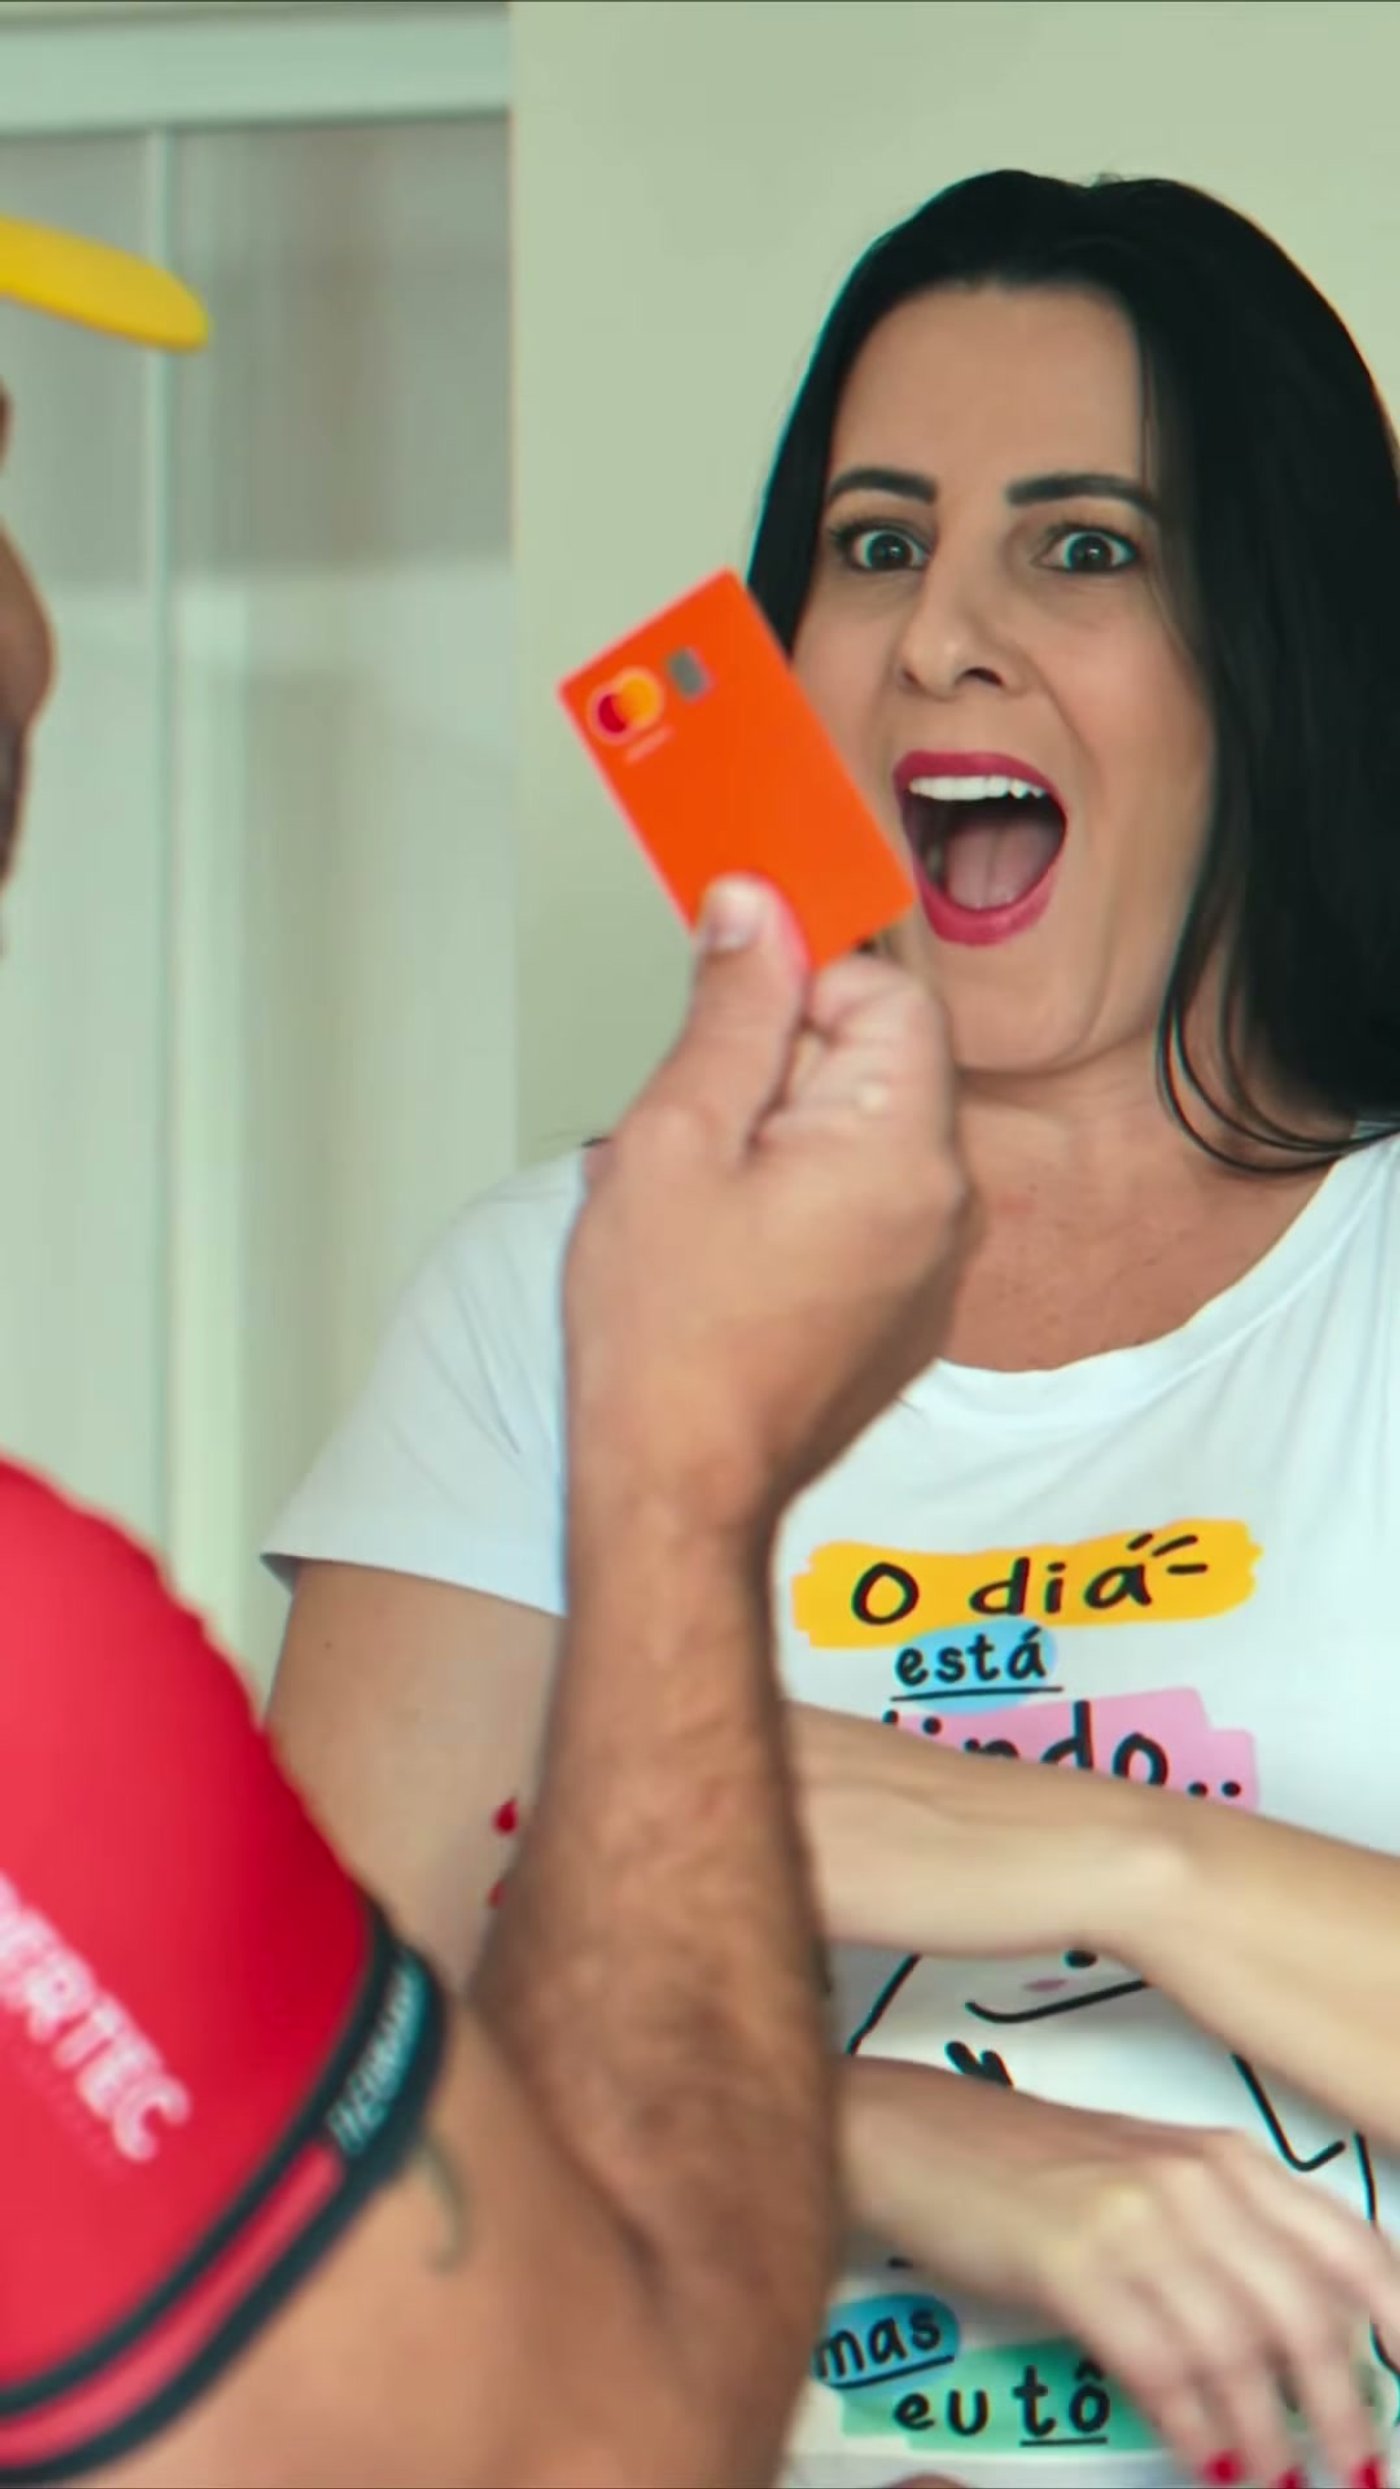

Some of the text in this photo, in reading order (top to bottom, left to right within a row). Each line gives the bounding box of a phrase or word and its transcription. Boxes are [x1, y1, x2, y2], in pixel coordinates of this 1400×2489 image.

[850, 1562, 919, 1626] O
[894, 1626, 1047, 1686] está
[813, 2308, 941, 2378] mas
[893, 2360, 1111, 2438] eu tô
